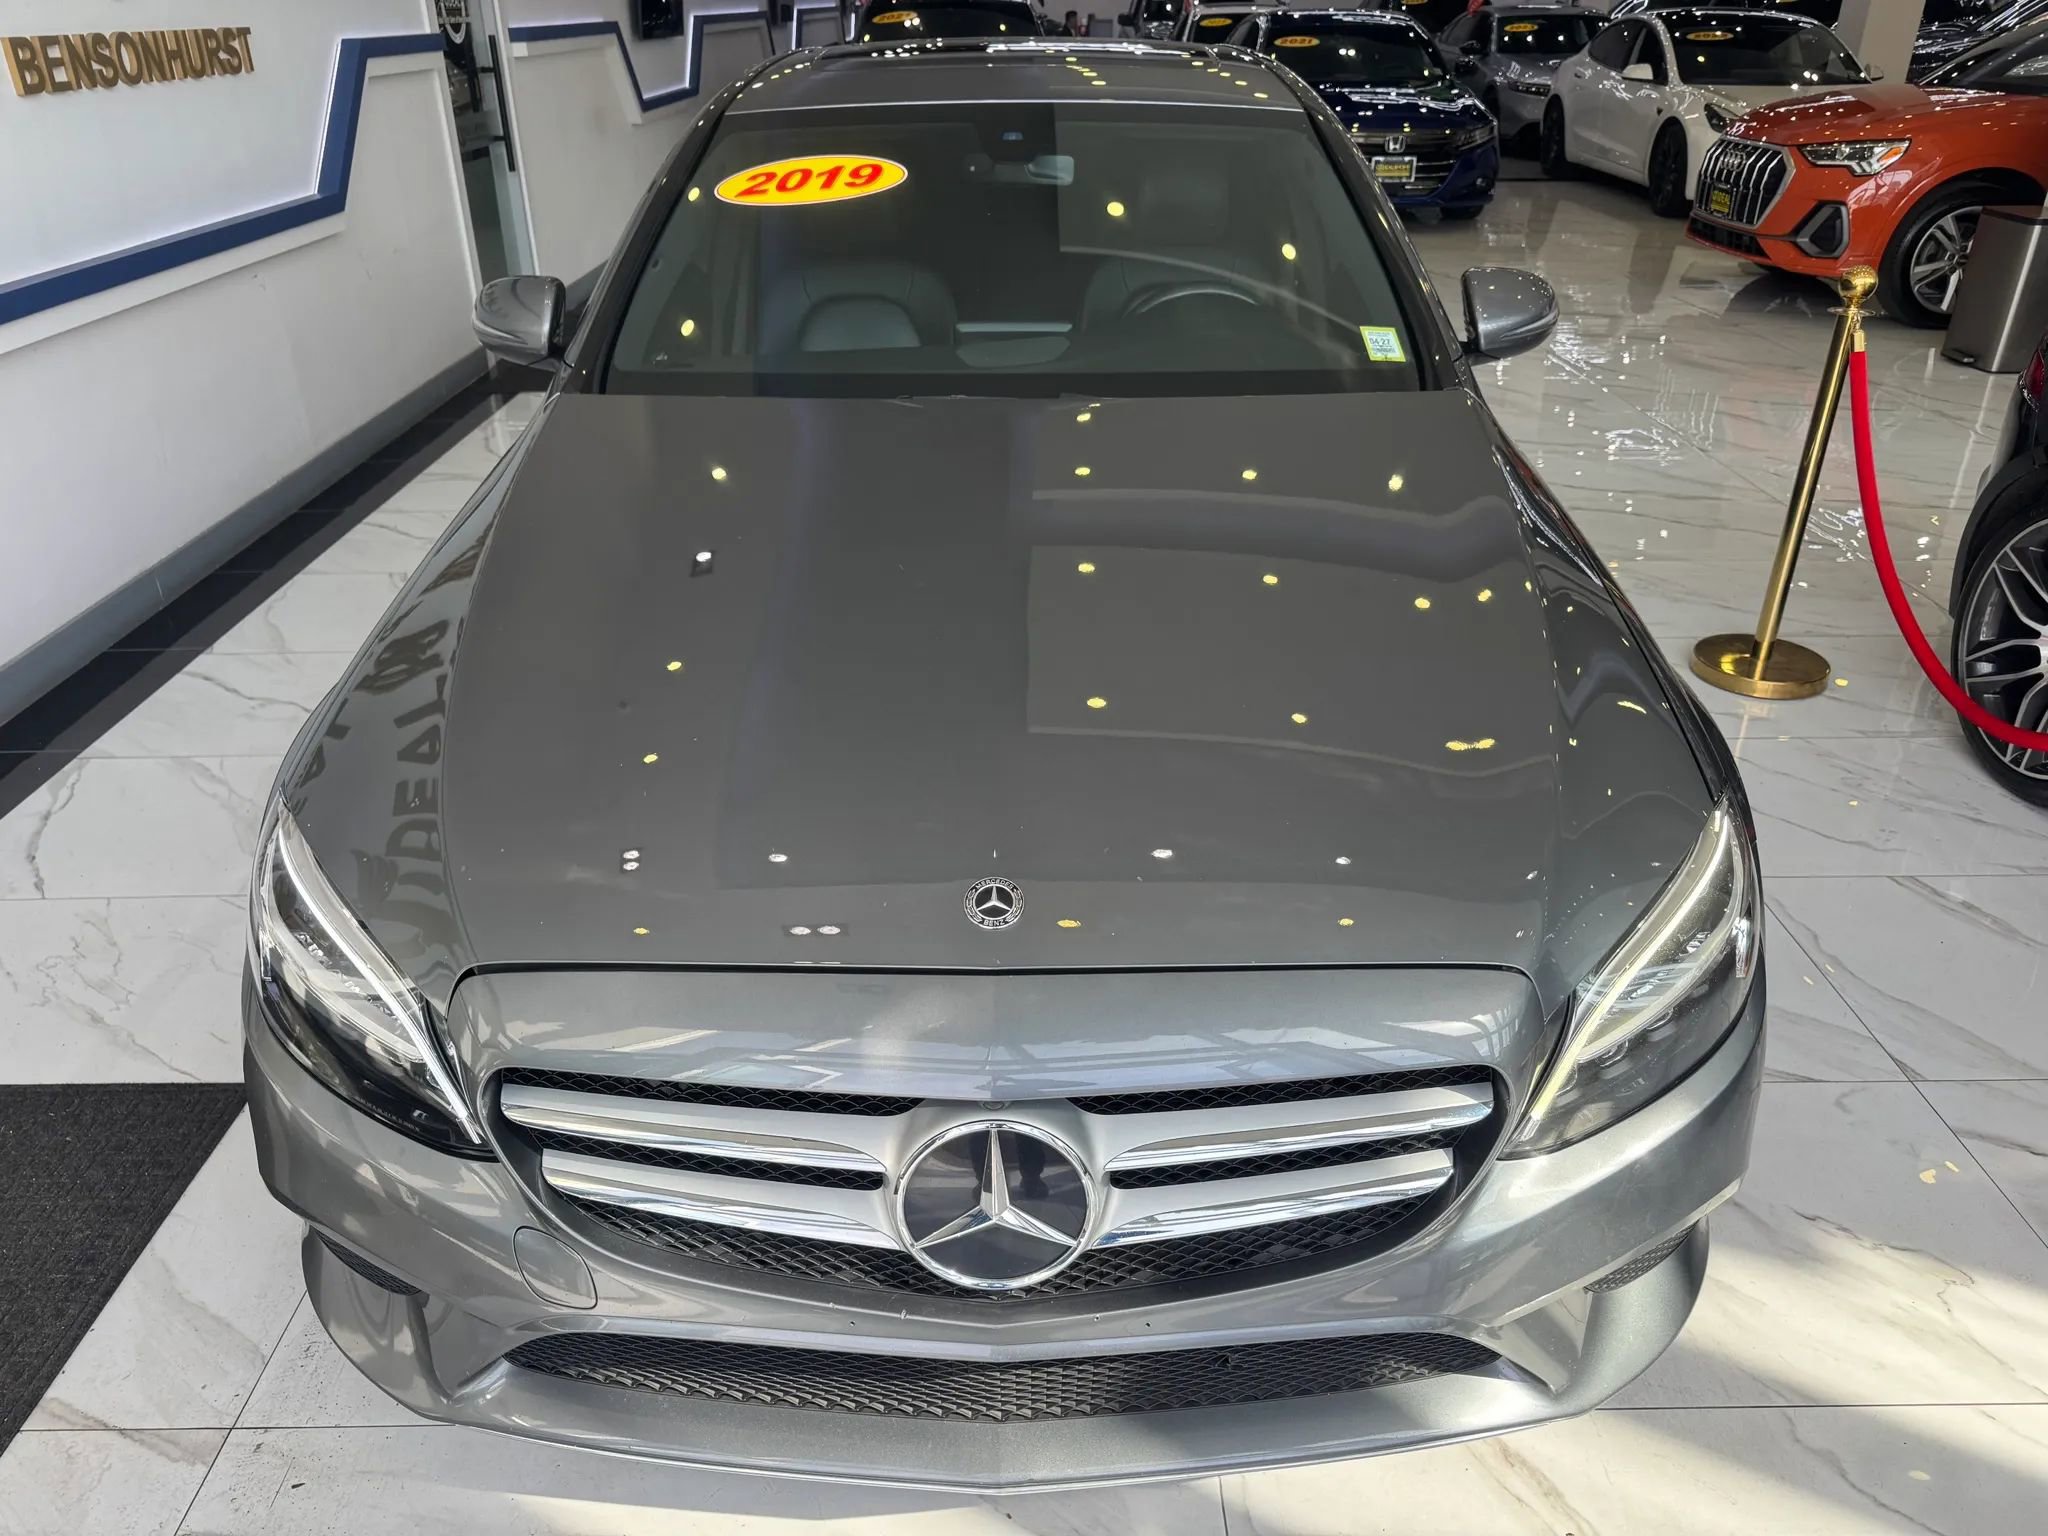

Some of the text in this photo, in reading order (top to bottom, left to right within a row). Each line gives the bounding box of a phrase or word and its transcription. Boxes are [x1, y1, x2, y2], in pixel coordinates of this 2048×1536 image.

[1279, 37, 1314, 45] 2021
[1, 26, 255, 97] BENSONHURST
[734, 163, 883, 198] 2019
[975, 878, 1014, 890] MERCEDES
[983, 918, 1006, 928] BENZ
